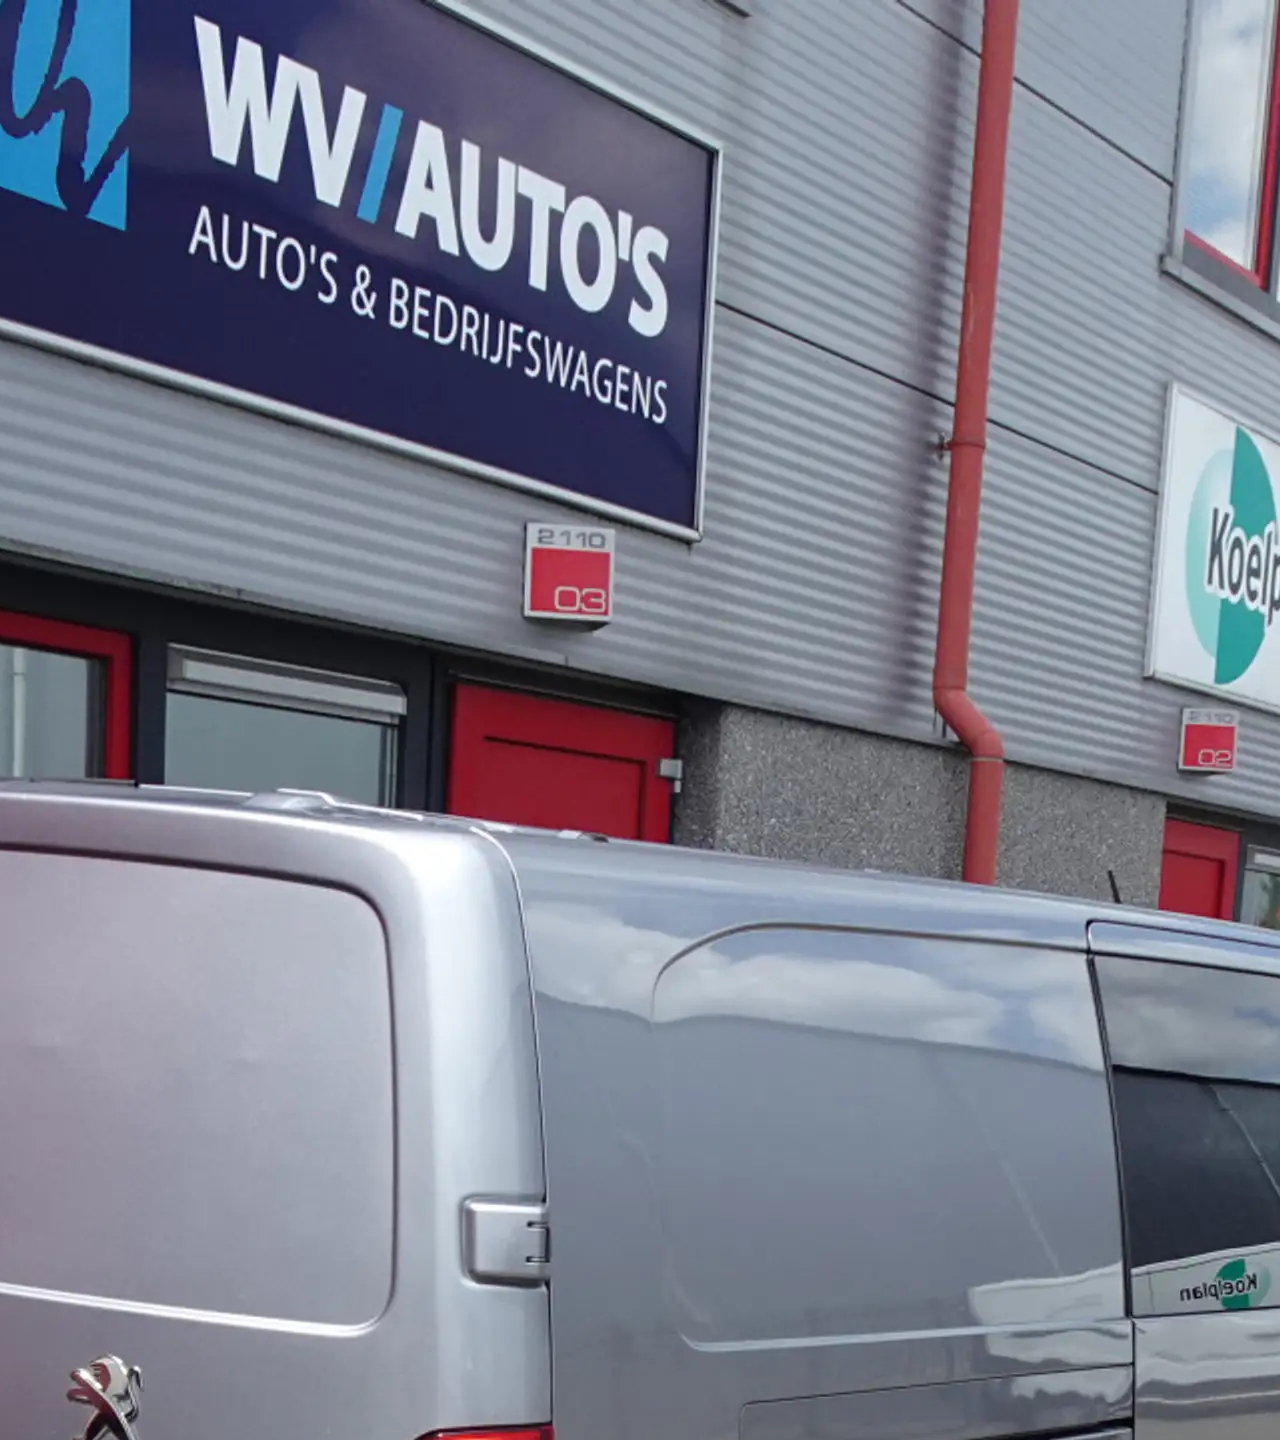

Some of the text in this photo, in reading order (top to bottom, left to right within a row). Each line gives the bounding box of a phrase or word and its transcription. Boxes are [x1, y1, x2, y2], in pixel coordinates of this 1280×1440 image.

[188, 204, 668, 425] AUTO'S & BEDRIJFSWAGENS
[538, 528, 607, 549] 2110
[554, 586, 607, 613] 03
[1198, 749, 1232, 768] 02
